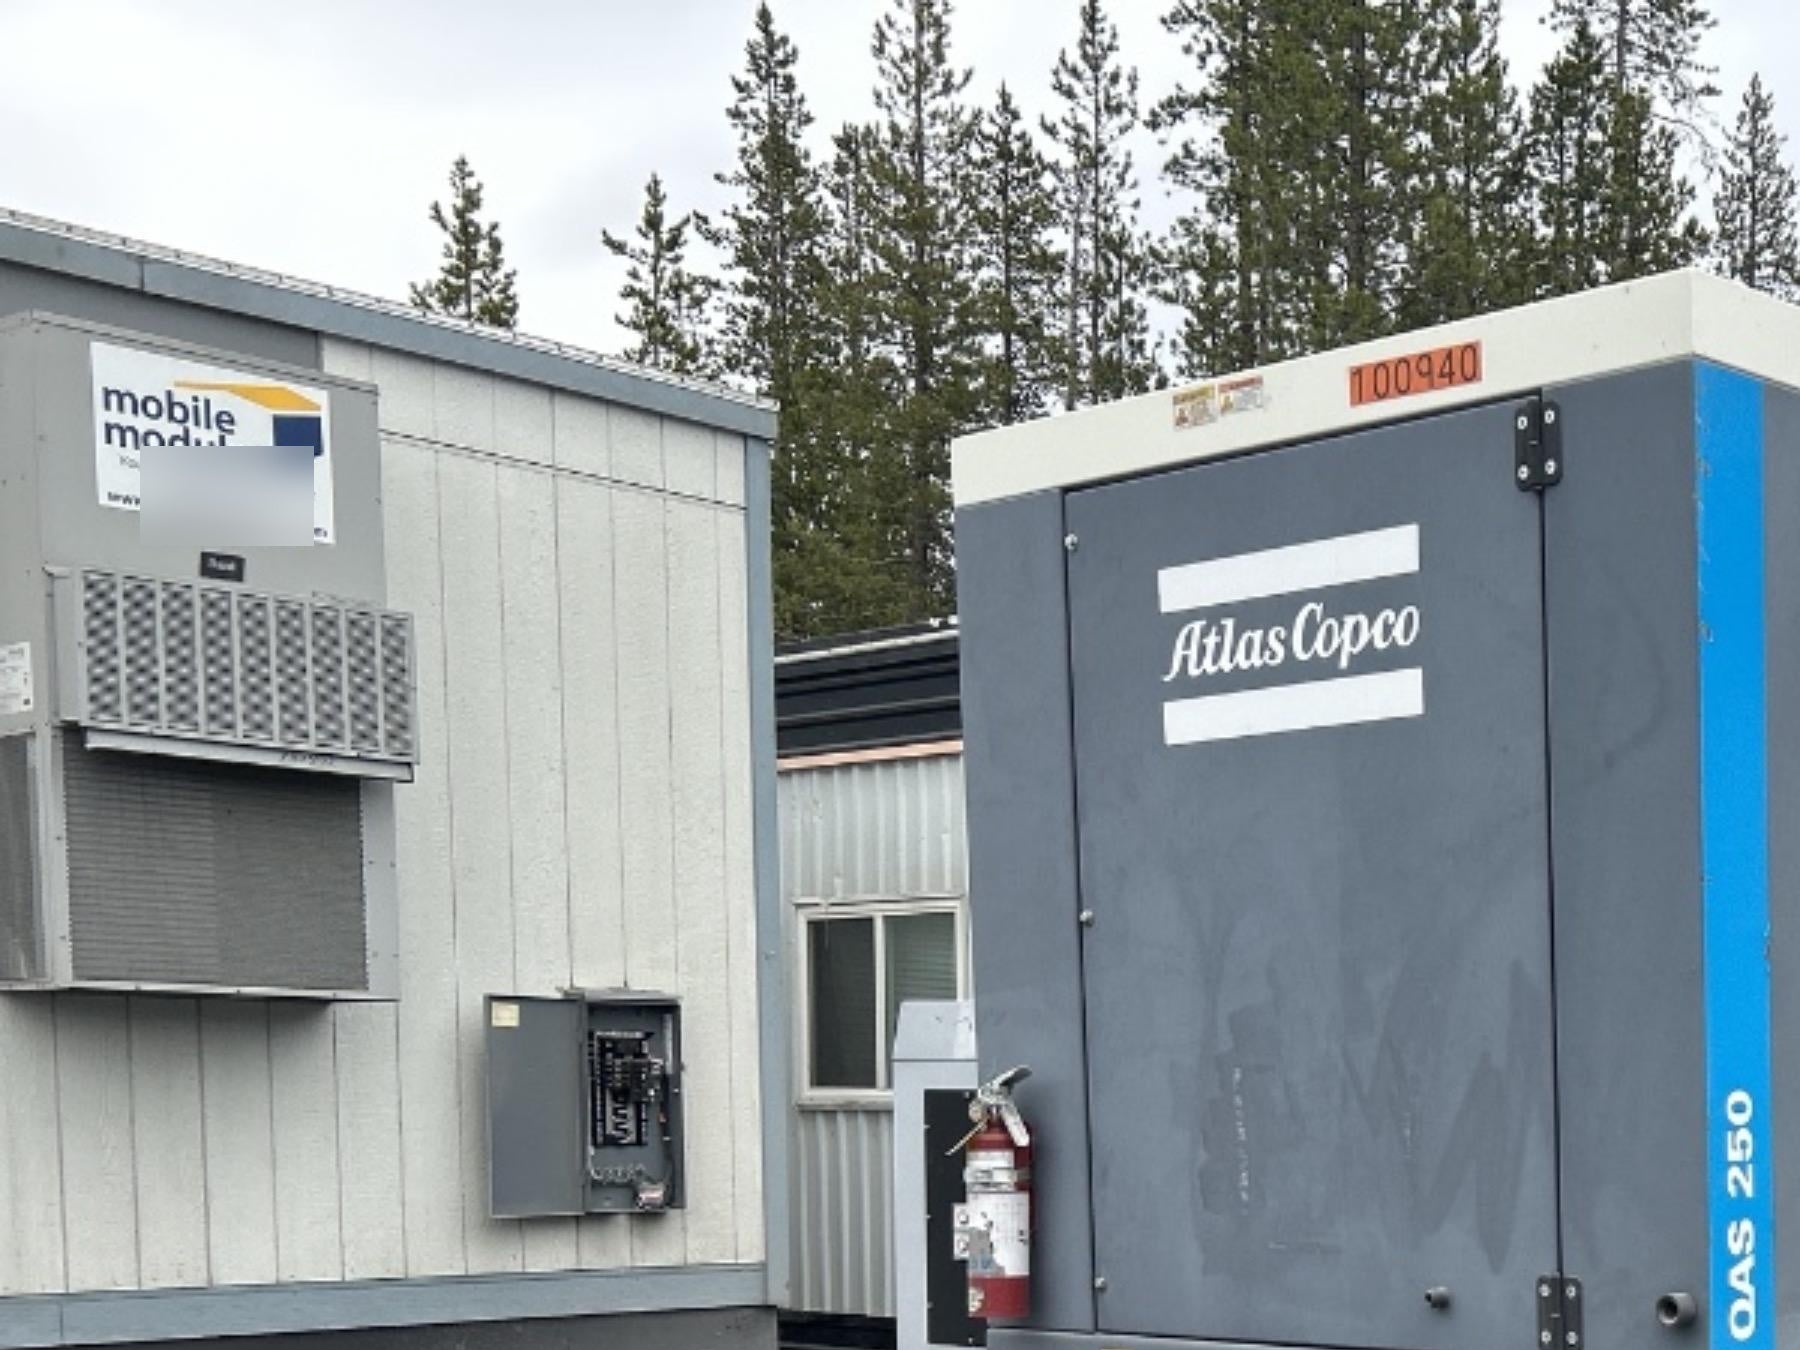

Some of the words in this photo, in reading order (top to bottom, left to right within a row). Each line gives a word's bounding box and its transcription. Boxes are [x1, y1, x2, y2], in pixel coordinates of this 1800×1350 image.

[102, 386, 236, 436] mobile
[1353, 344, 1478, 402] 100940
[1161, 616, 1286, 682] Atlas
[1291, 601, 1421, 669] Copco
[1726, 1089, 1754, 1198] 250
[1728, 1217, 1757, 1341] QAS
